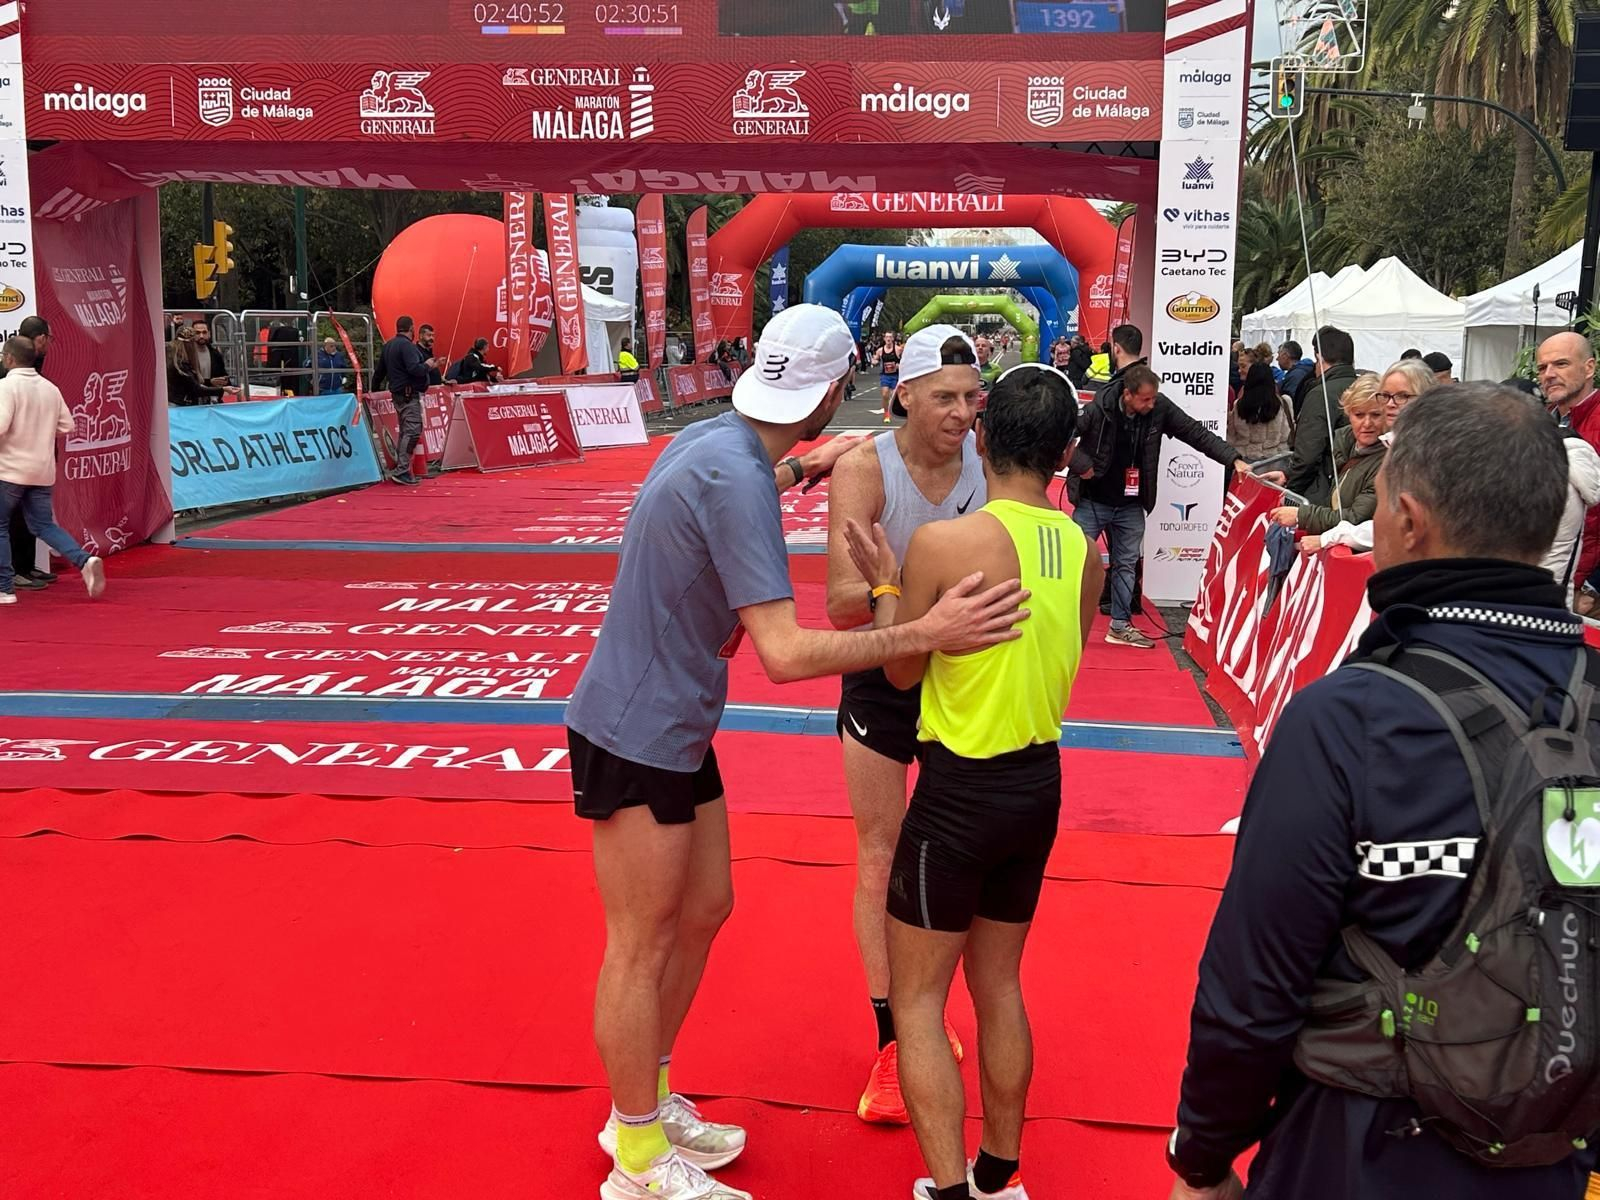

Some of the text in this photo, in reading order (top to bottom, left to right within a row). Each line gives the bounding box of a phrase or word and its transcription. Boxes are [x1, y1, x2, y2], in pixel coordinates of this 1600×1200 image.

[474, 3, 564, 23] 02:40:52
[595, 4, 679, 24] 02:30:51
[1040, 8, 1096, 29] 1392
[530, 68, 620, 86] GENERALI
[240, 87, 291, 101] Ciudad
[1072, 86, 1127, 101] Ciudad
[575, 95, 620, 109] MARATÓN
[241, 104, 313, 120] de Málaga
[1072, 104, 1150, 120] de Málaga
[360, 120, 435, 135] GENERALI
[532, 106, 624, 140] MÁLAGA
[733, 119, 809, 136] GENERALI
[1182, 180, 1214, 190] luanvi
[871, 192, 1005, 213] GENERALI
[1184, 209, 1230, 222] vithas
[510, 192, 528, 301] GENERA
[550, 193, 579, 312] GENERAL
[10, 259, 27, 268] Tec
[1162, 249, 1228, 263] BYD
[875, 253, 980, 281] luanvi
[1161, 267, 1226, 277] Caetano Tec
[1172, 304, 1213, 313] Gourmet
[1158, 341, 1223, 356] Vitaldin
[1162, 372, 1214, 384] POWER
[1185, 384, 1214, 396] ADE
[500, 404, 538, 419] GENERALI
[576, 406, 631, 426] ENERALI
[170, 424, 353, 477] ORLD ATHLETICS
[507, 431, 549, 457] MÁLAGA
[64, 446, 131, 481] GENERALI
[1166, 468, 1204, 478] Natura
[427, 581, 614, 591] GENER
[379, 596, 610, 613] MÁLAG
[348, 622, 602, 637] GENER
[264, 649, 589, 665] GENERALI
[389, 666, 560, 678] MARATÓN
[181, 671, 549, 699] MÁLAGA
[89, 739, 572, 773] GENERAL
